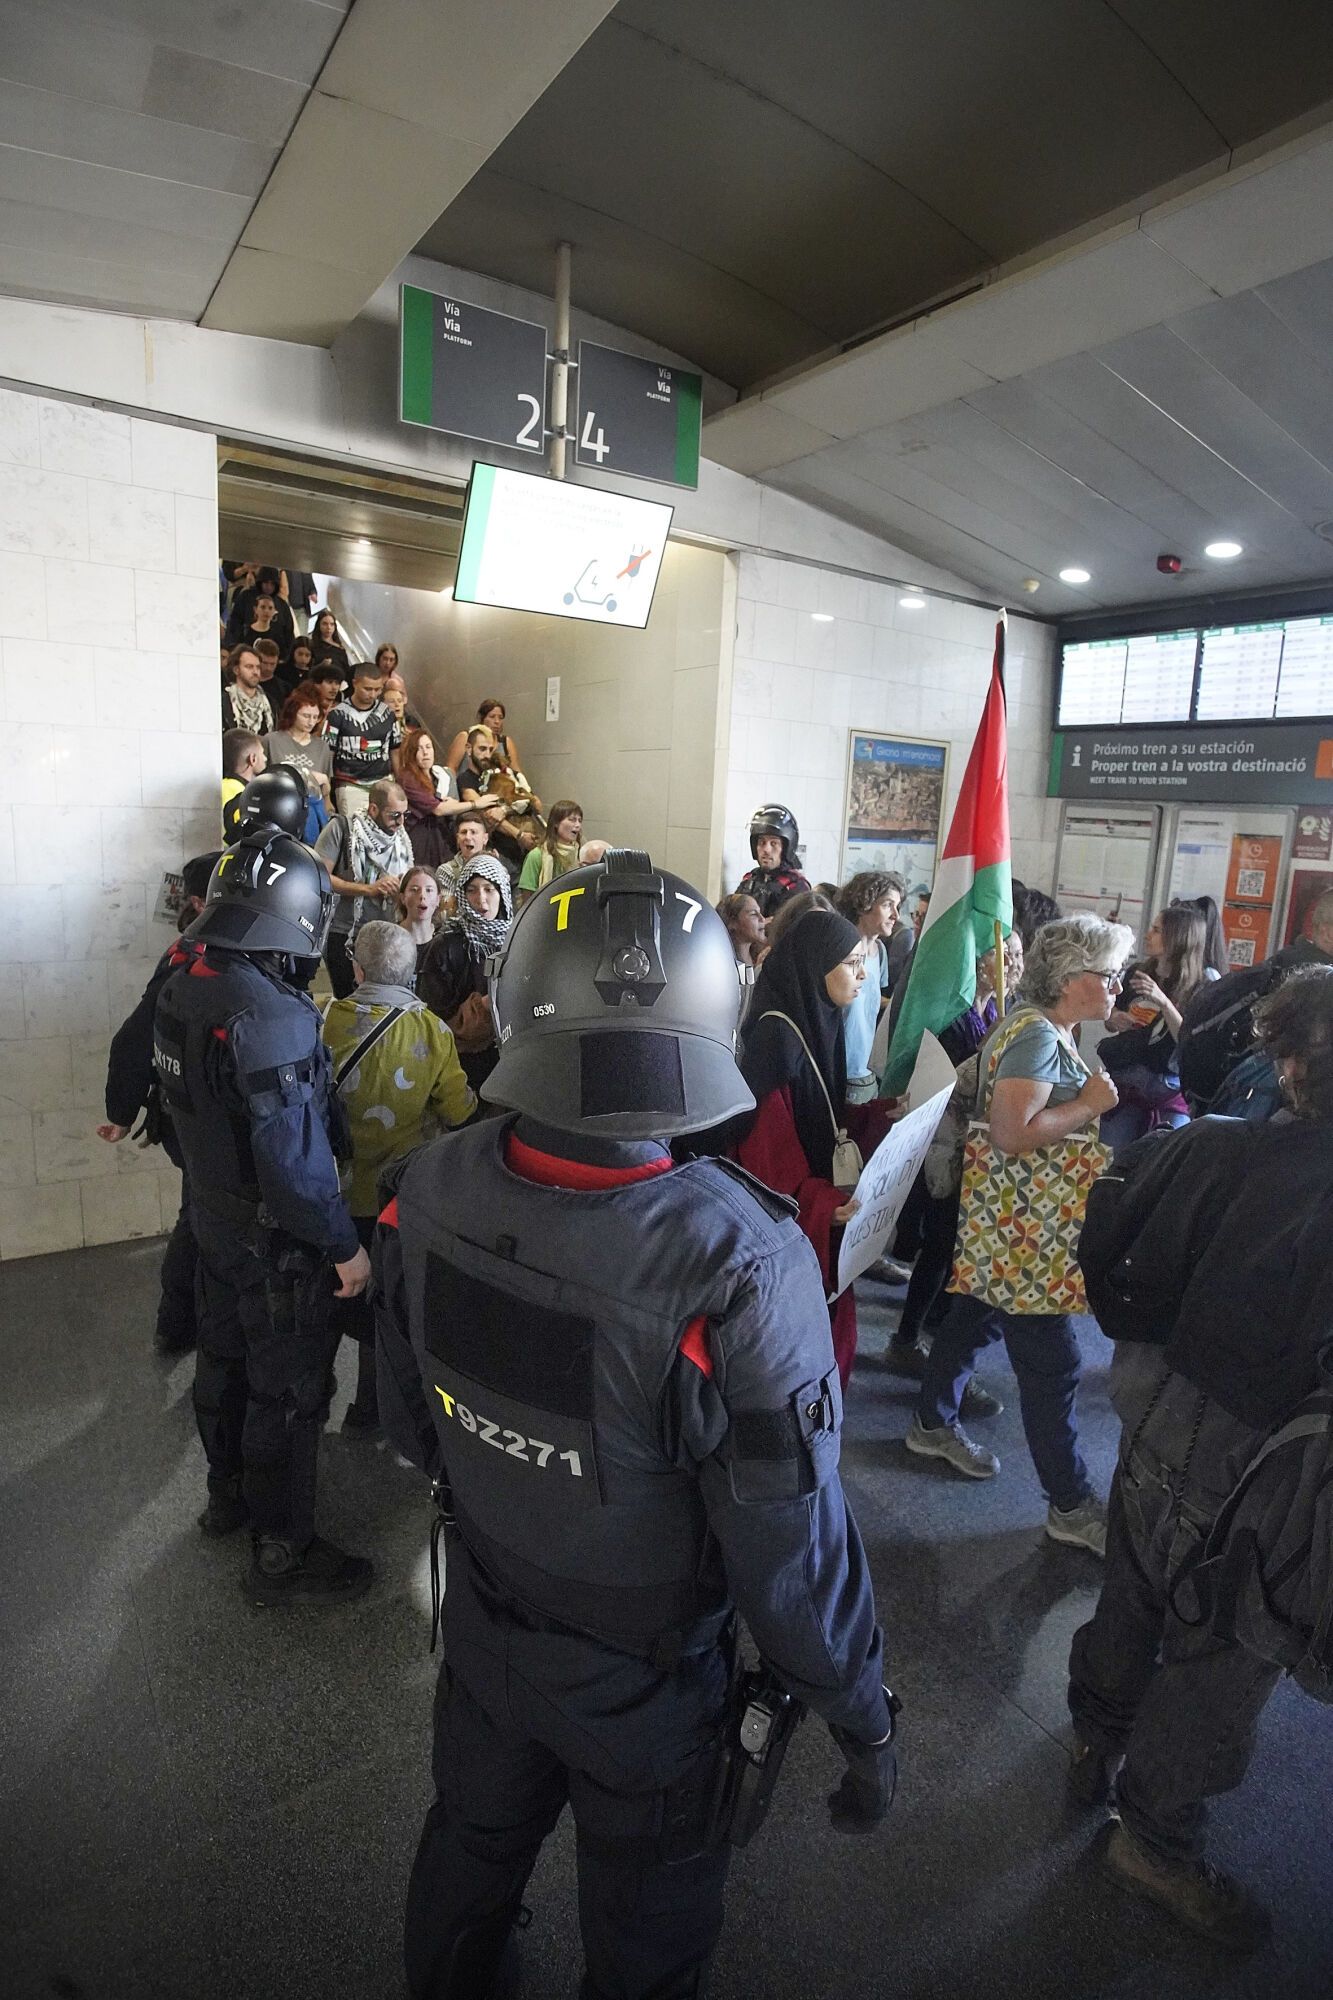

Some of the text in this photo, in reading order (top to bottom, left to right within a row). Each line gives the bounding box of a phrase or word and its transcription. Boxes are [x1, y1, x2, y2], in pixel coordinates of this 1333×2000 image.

[444, 302, 460, 316] Vía
[444, 317, 461, 333] Via
[443, 333, 472, 346] PLATFORM
[657, 380, 671, 394] Via
[646, 391, 671, 403] PLATFORM
[516, 393, 540, 448] 2
[581, 411, 610, 462] 4
[1093, 740, 1255, 755] Próximo tren a su estación
[1091, 758, 1307, 774] Proper tren a la vostra destinació
[1089, 776, 1188, 785] NEXT TRAIN TO YOUR STATION
[218, 855, 287, 886] T 7
[550, 888, 702, 933] T 7
[533, 1003, 555, 1017] 0530
[434, 1384, 583, 1477] T9Z271
